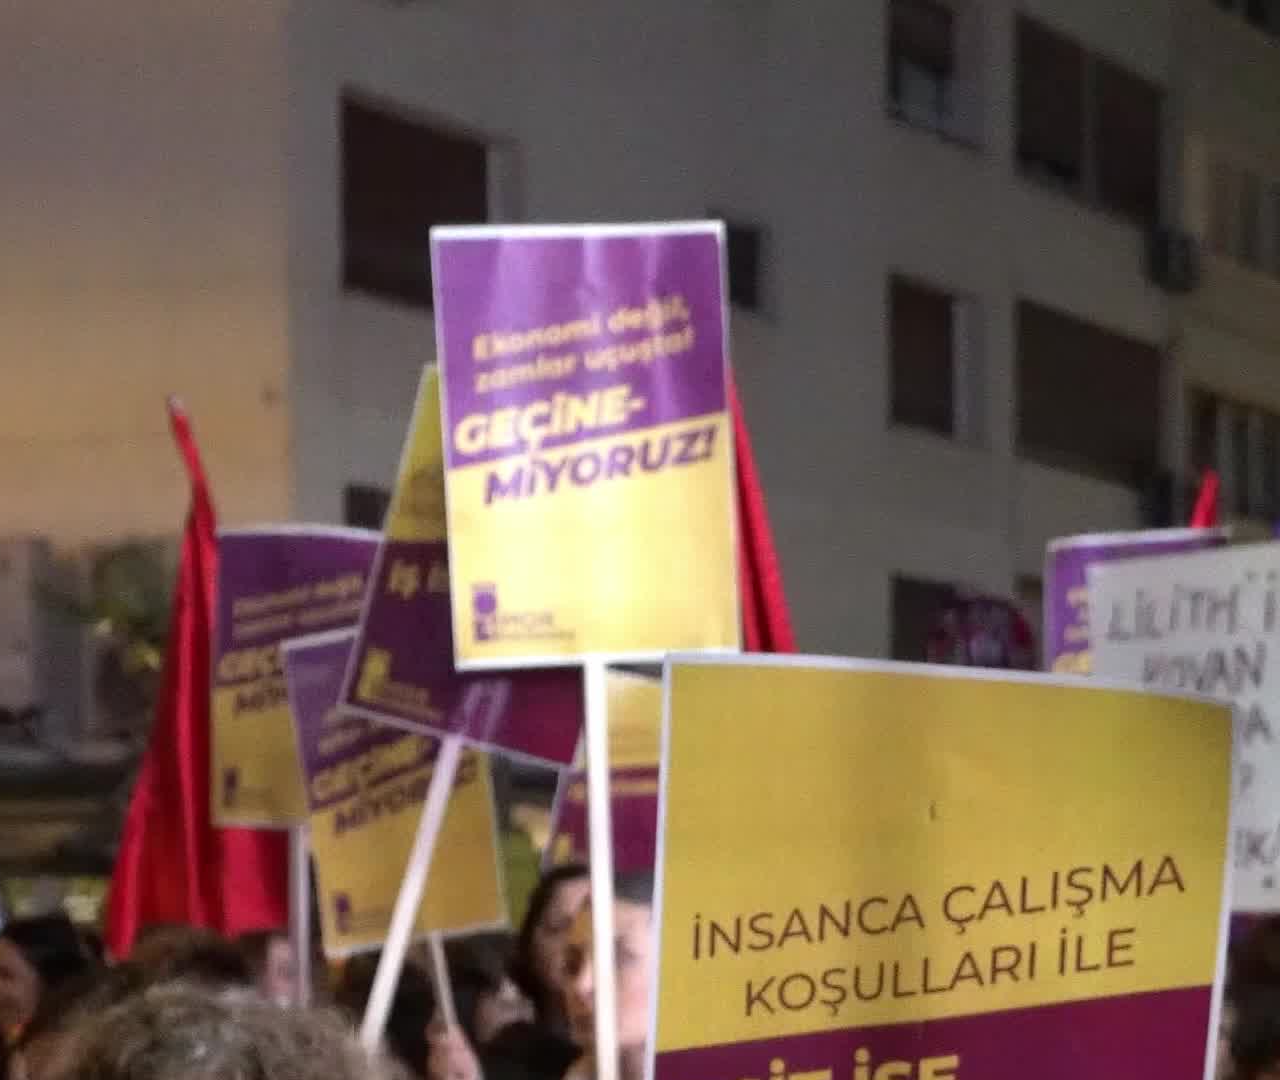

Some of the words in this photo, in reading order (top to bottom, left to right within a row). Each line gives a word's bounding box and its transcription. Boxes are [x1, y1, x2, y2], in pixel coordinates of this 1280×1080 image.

[453, 384, 648, 458] GEÇİNE-
[483, 424, 718, 506] MİYORUZ!
[692, 892, 925, 960] İNSANCA
[943, 855, 1186, 937] ÇALIŞMA
[744, 939, 1038, 1018] KOŞULLARI
[1057, 926, 1137, 978] İLE
